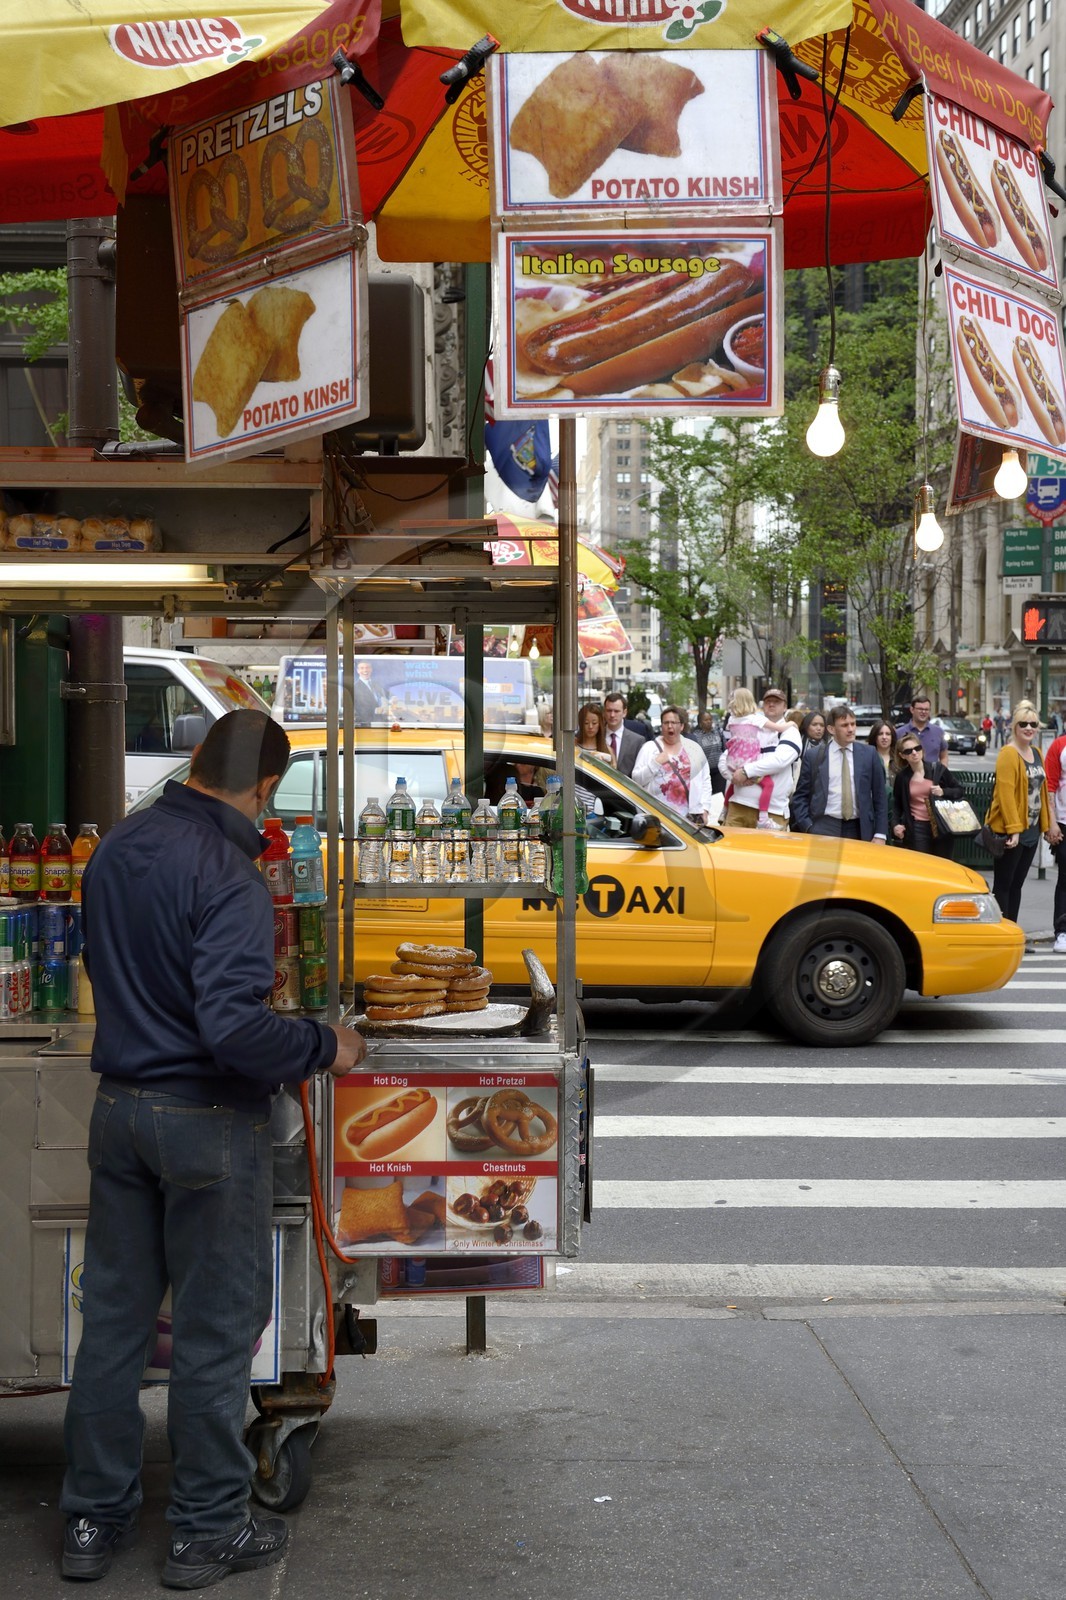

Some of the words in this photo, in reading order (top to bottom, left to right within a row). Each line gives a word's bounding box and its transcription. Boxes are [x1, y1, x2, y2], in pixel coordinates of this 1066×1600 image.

[906, 24, 955, 84] Beef
[957, 59, 997, 109] Hot
[180, 80, 324, 175] PRETZELS
[933, 96, 991, 151] CHILI
[994, 130, 1036, 178] DOG
[591, 177, 680, 199] POTATO
[687, 176, 759, 198] KINSH
[521, 253, 605, 275] Italian
[612, 253, 721, 279] Sausage
[952, 282, 1011, 329] CHILI
[1017, 309, 1056, 349] DOG
[243, 394, 299, 431] POTATO
[303, 378, 350, 413] KINSH
[1027, 455, 1039, 475] W
[373, 1076, 388, 1085] Hot
[390, 1076, 408, 1087] Dog
[479, 1076, 494, 1086] Hot
[496, 1076, 526, 1086] Pretzel
[369, 1162, 384, 1172] Hot
[387, 1162, 412, 1172] Knish
[482, 1162, 526, 1172] Chestnuts
[453, 1240, 470, 1249] Only
[472, 1239, 494, 1248] Winter
